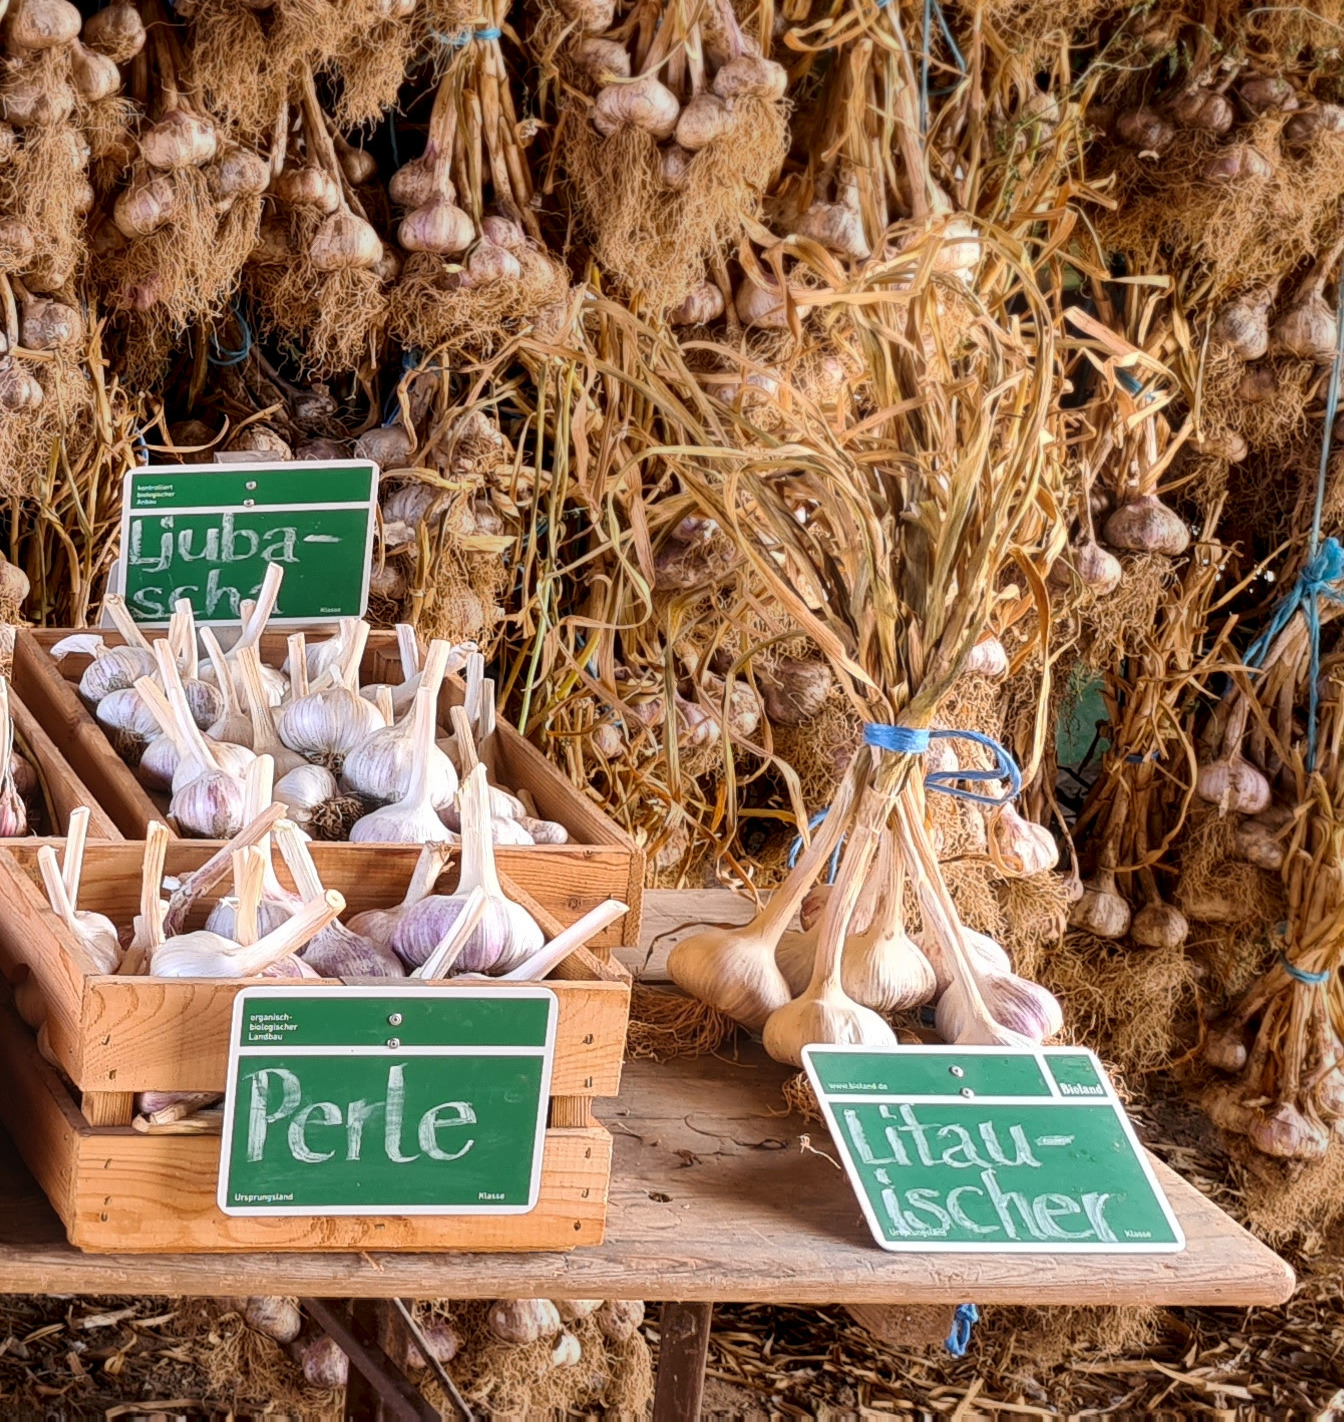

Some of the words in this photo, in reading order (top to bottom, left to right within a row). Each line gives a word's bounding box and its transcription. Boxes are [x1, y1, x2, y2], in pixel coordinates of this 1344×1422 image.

[129, 512, 342, 573] Ljuba-
[128, 569, 284, 619] sch
[250, 1014, 292, 1024] organisch-
[249, 1023, 298, 1032] biologischer
[248, 1032, 283, 1041] Landbau
[1060, 1083, 1104, 1096] Bioland
[242, 1063, 477, 1163] Perle
[844, 1104, 1075, 1168] Litau-
[234, 1193, 293, 1203] Ursprungsland
[478, 1192, 505, 1201] Klasse
[873, 1167, 1118, 1242] ischer
